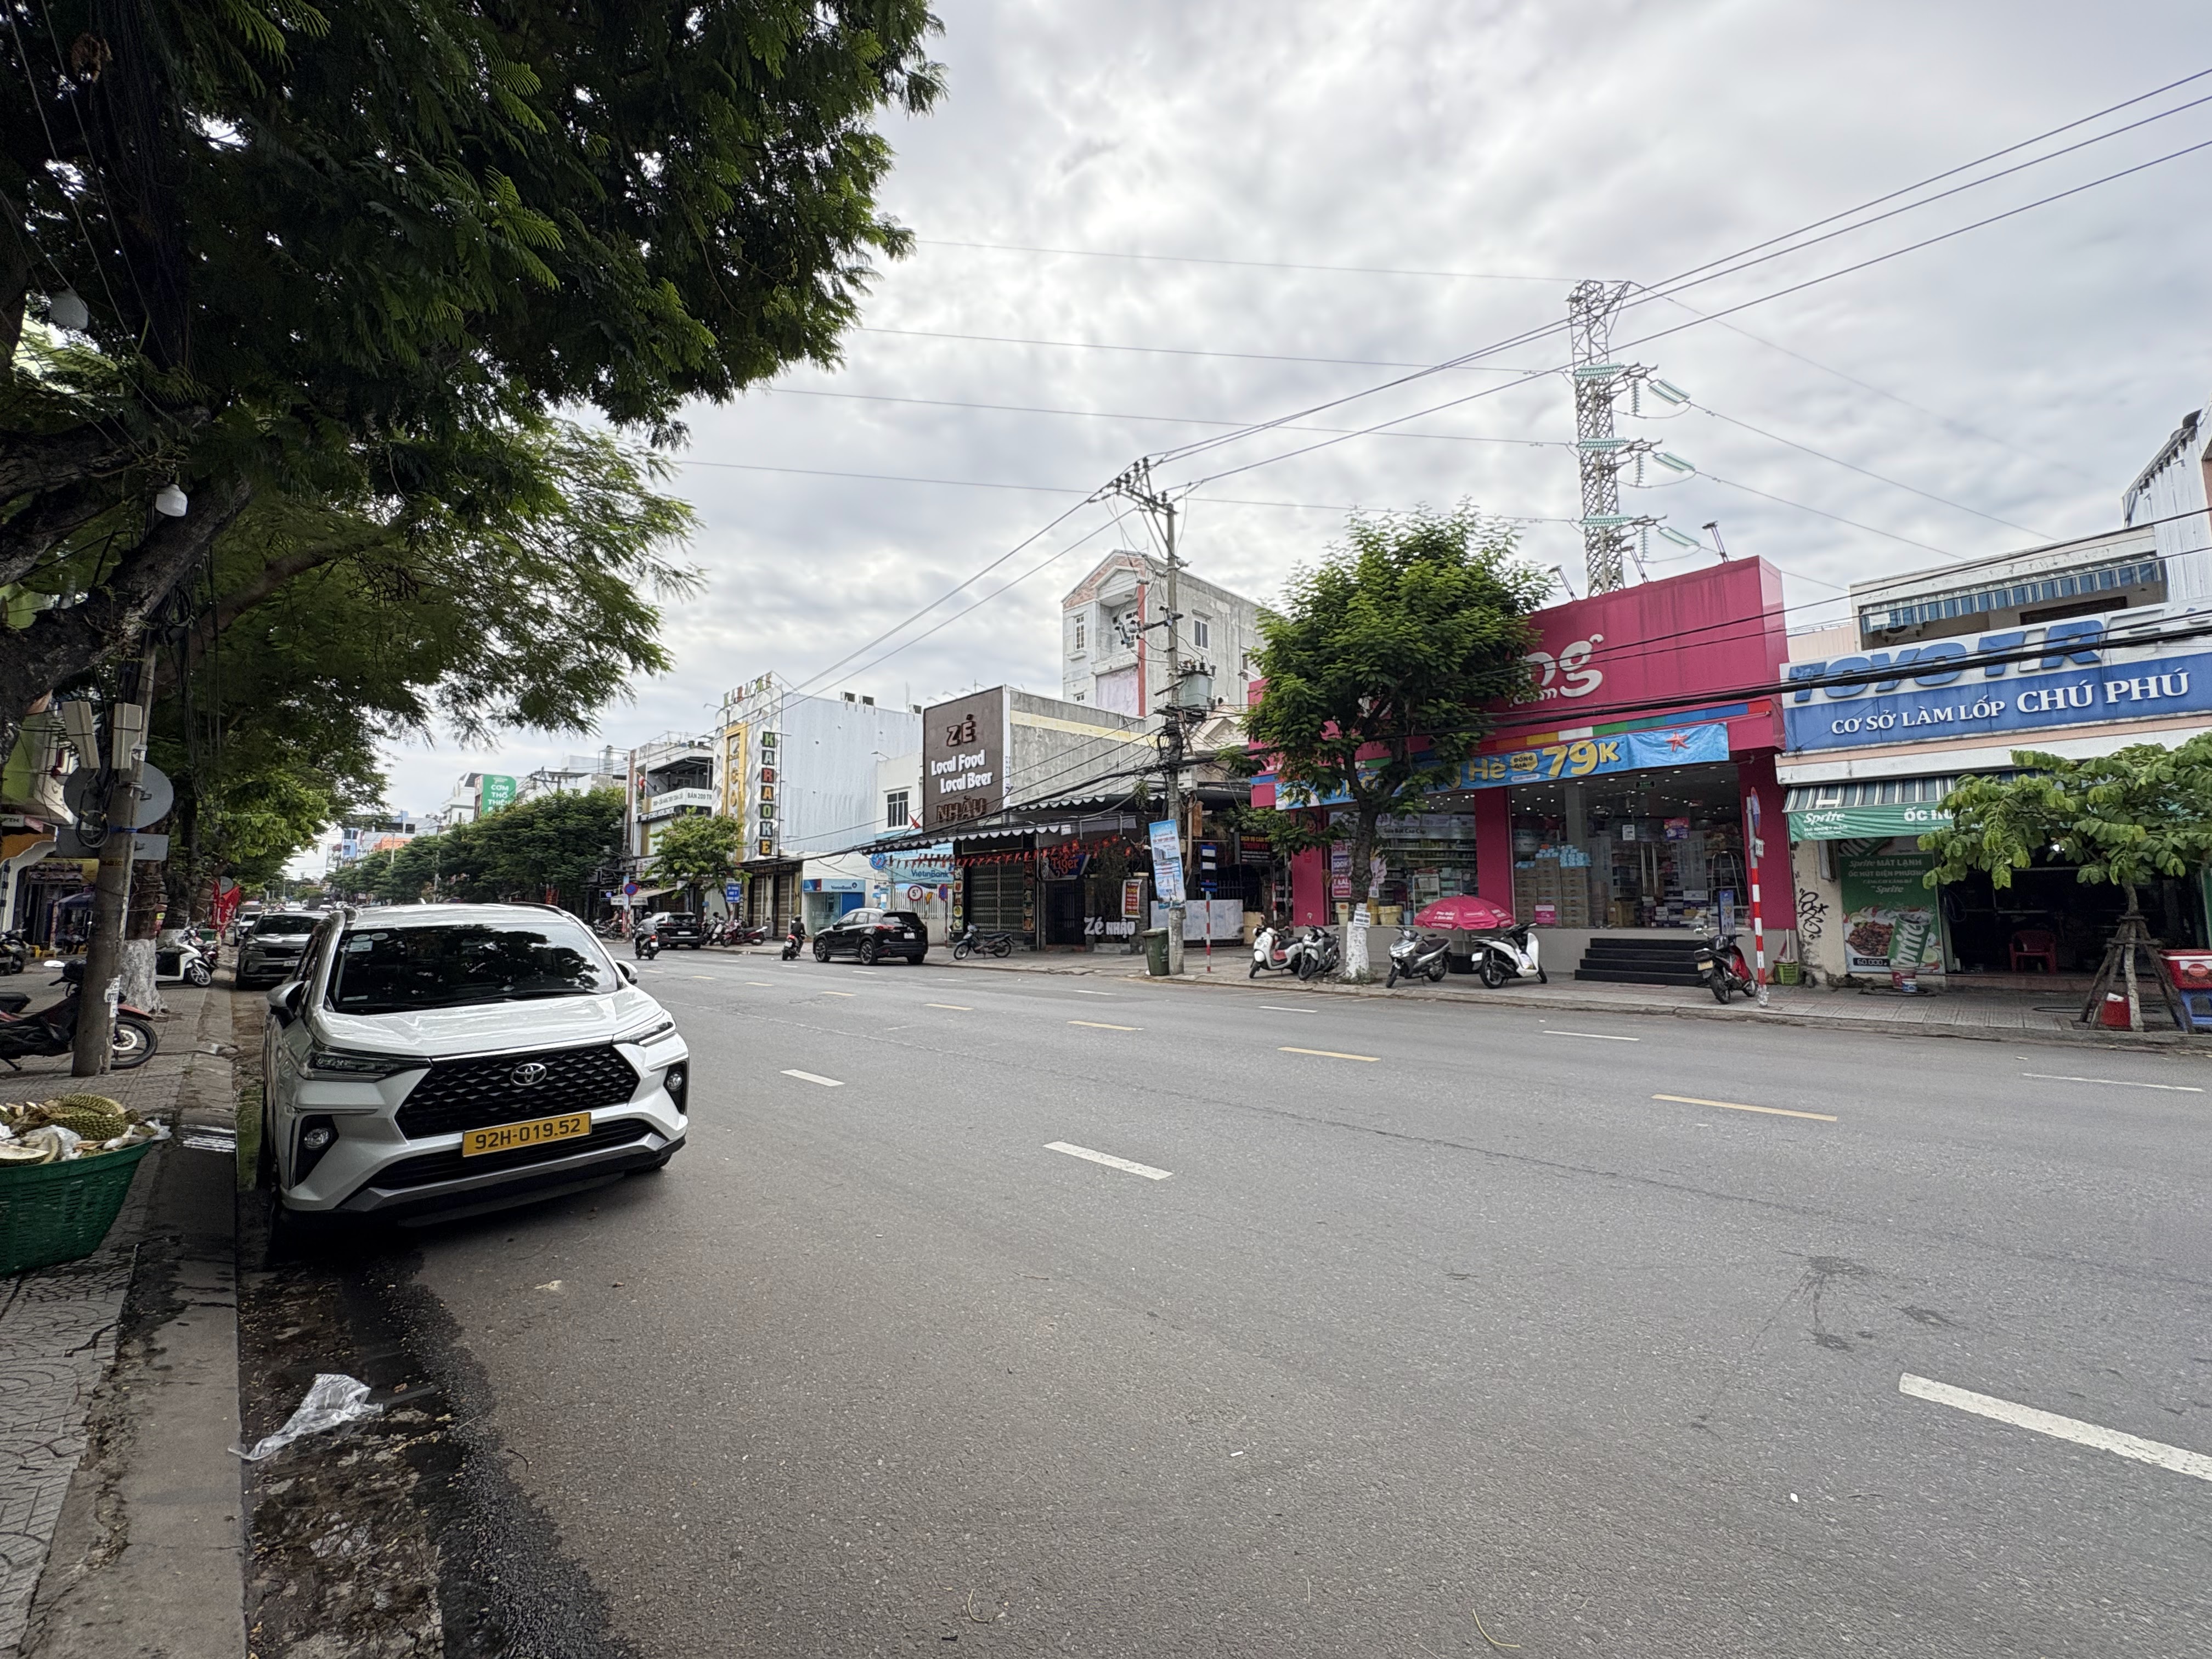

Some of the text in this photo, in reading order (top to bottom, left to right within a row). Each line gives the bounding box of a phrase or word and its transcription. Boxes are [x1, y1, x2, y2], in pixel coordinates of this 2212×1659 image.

[1788, 642, 1967, 703] TOYO
[1831, 667, 2191, 735] CƠ SỞ LÀM LỐP CHÚ PHÚ
[946, 714, 977, 747] ZÉ
[931, 749, 985, 776] Local Food
[1469, 758, 1506, 781] Hè
[760, 732, 775, 855] KARAOKE
[940, 774, 966, 794] Local
[967, 772, 993, 789] Beer
[1803, 811, 1846, 826] Sprite
[1904, 806, 1928, 822] ỐC
[911, 869, 949, 878] VietinBank
[1051, 856, 1079, 875] Tiger
[1876, 885, 1904, 894] Sprite
[1084, 916, 1104, 935] Zé
[475, 1118, 580, 1150] 92H-019.52
